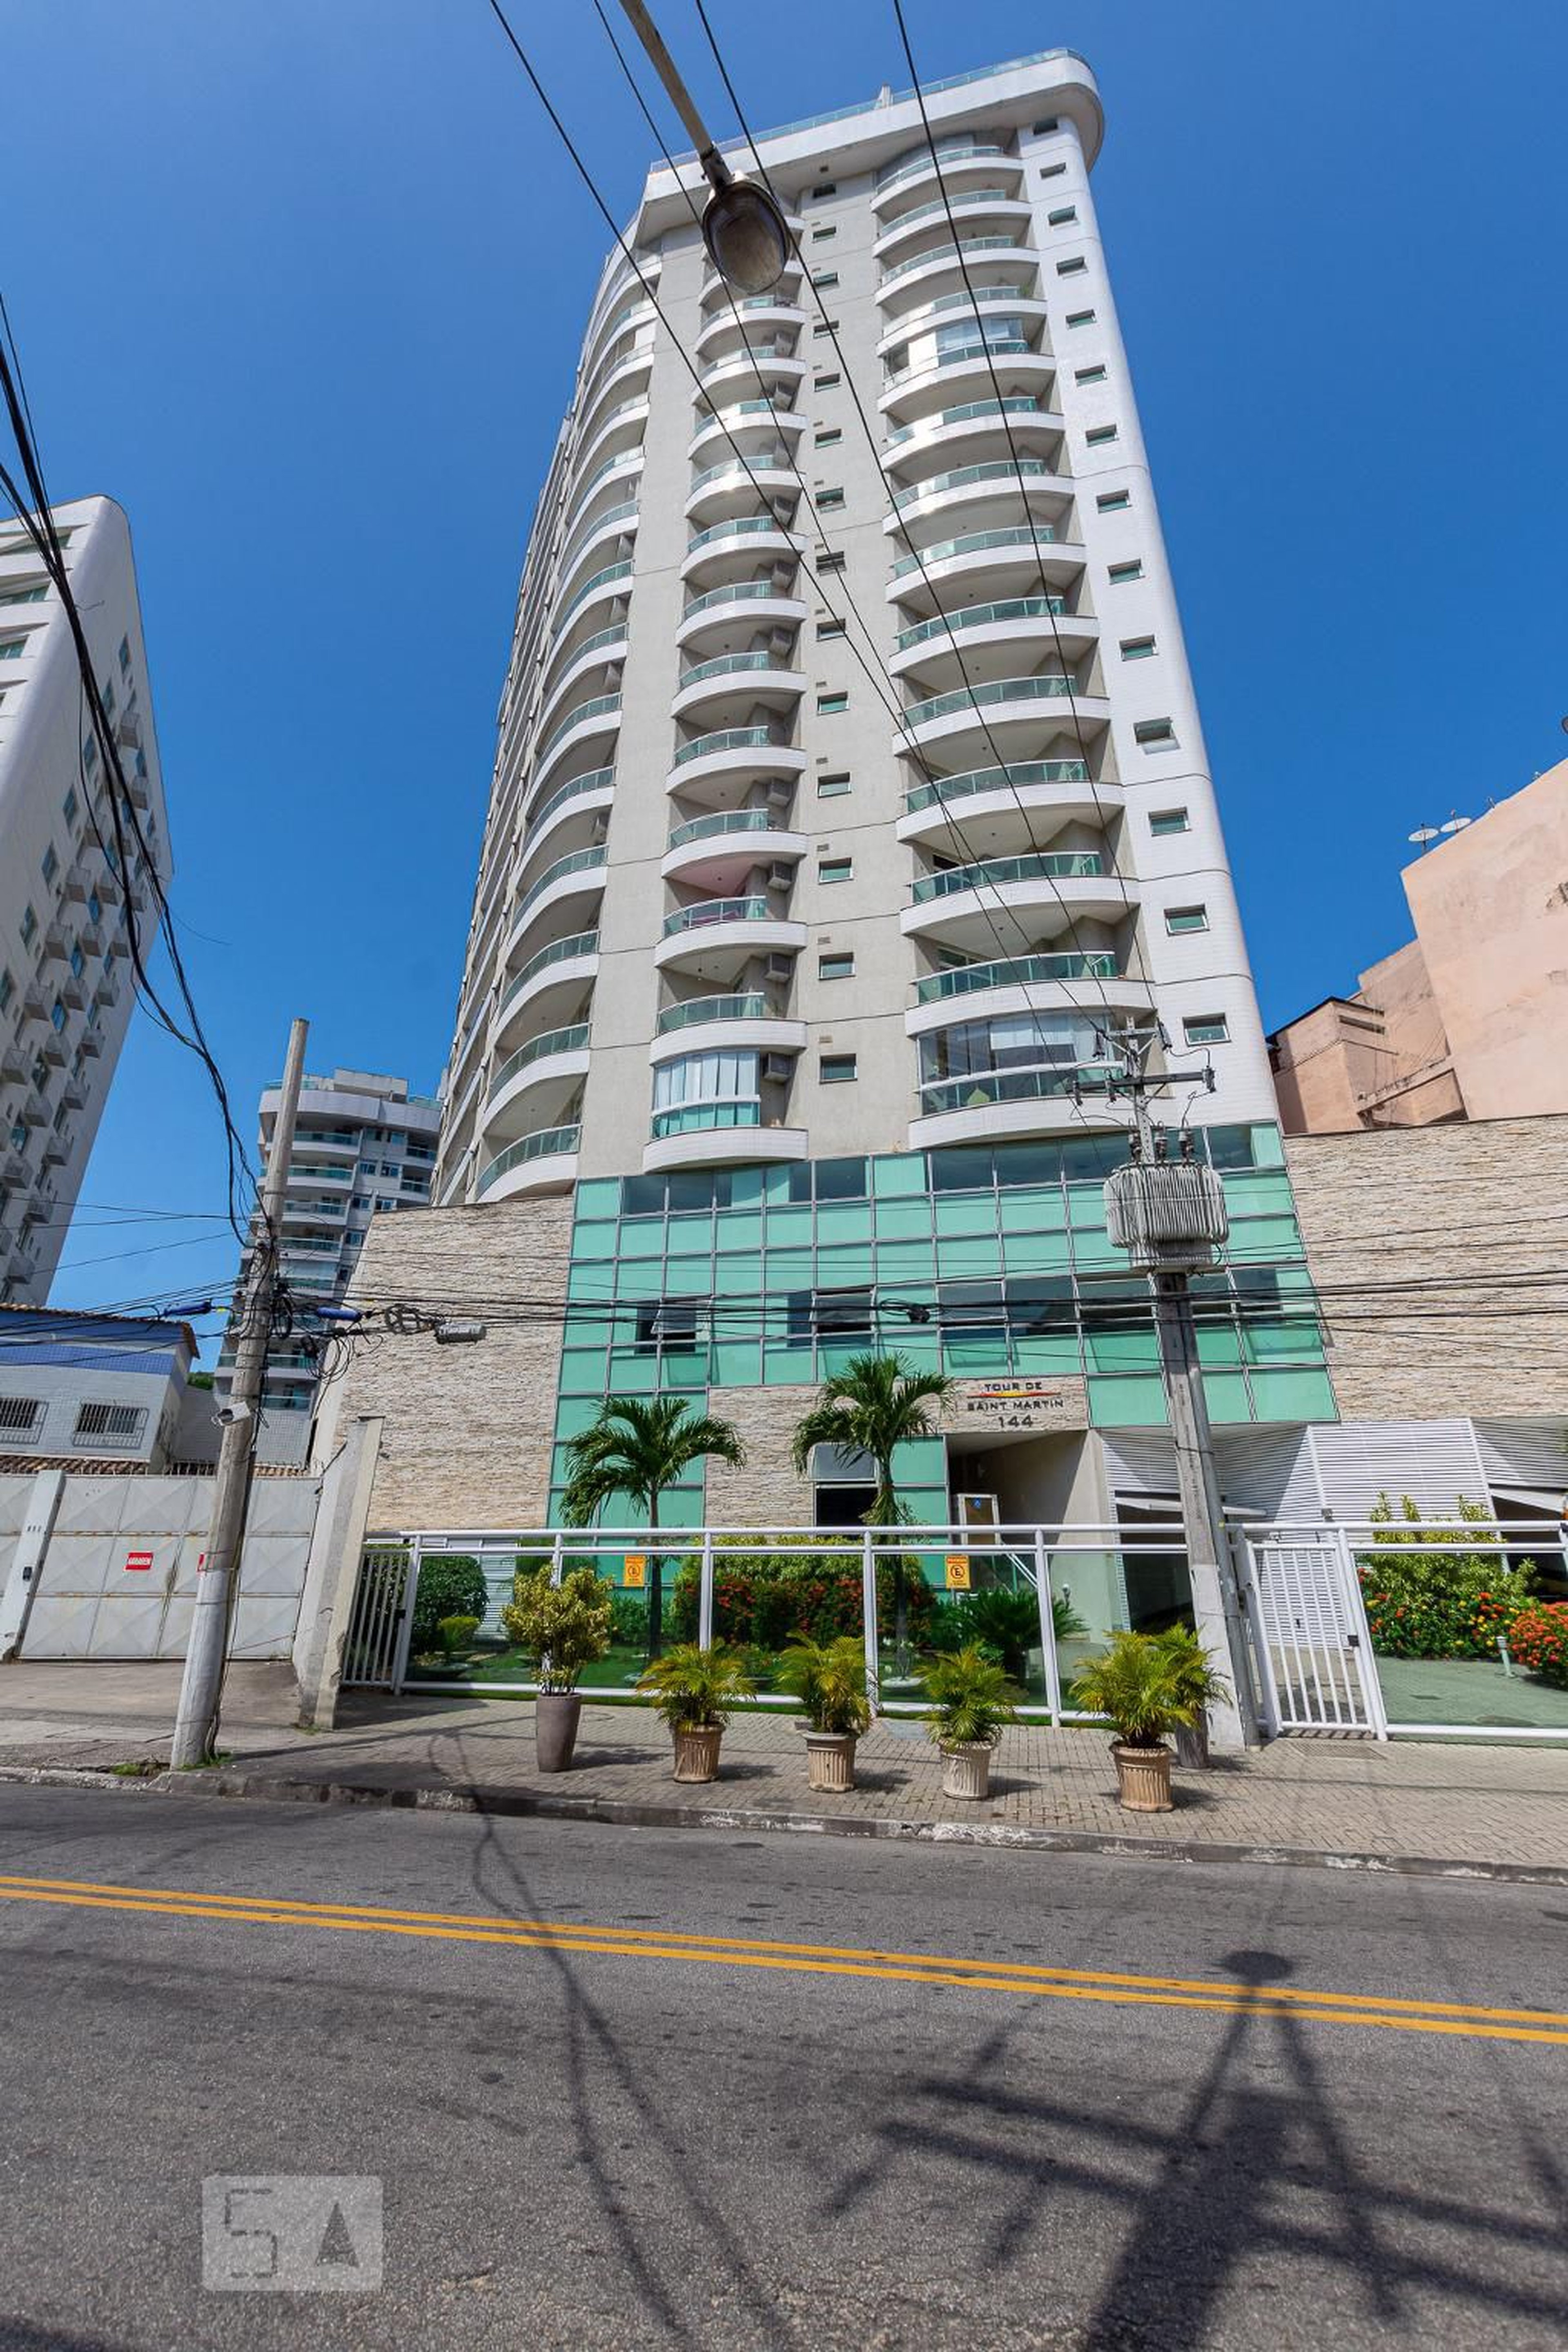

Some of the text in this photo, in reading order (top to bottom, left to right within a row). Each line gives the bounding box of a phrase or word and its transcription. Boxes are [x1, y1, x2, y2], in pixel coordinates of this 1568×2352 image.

[985, 1383, 1019, 1391] TOUR
[968, 1401, 1063, 1411] SAINT MARTIN
[998, 1415, 1033, 1428] 144
